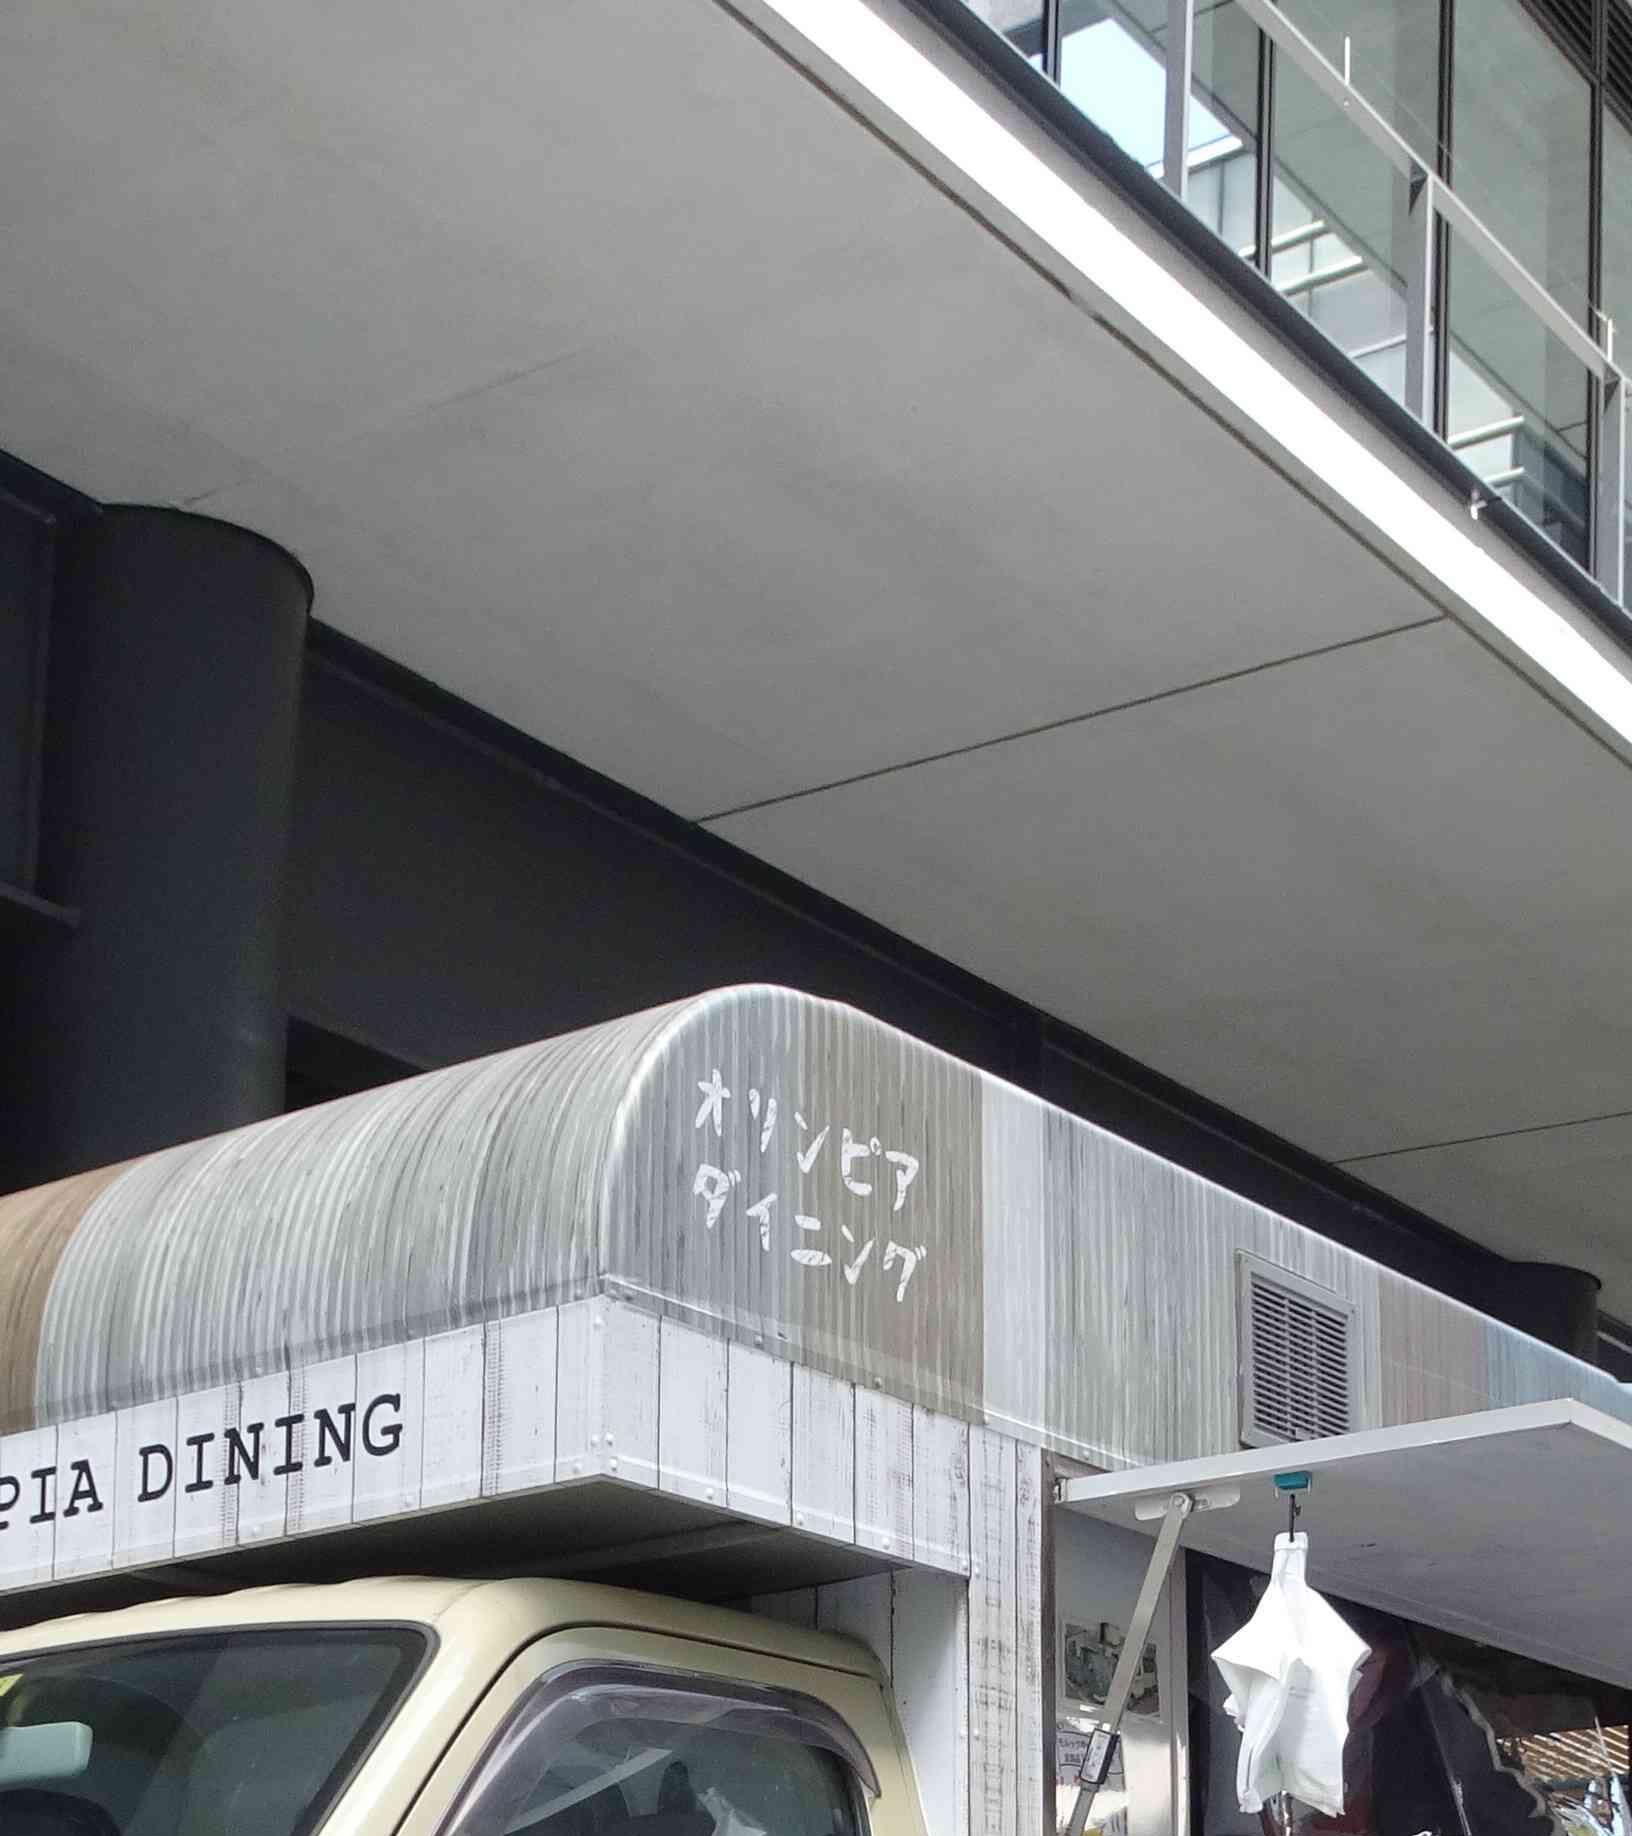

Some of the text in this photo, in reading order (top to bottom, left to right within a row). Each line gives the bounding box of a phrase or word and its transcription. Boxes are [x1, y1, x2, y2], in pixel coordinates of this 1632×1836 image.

[695, 1068, 919, 1212] オリンピア
[693, 1163, 927, 1303] ダイニング
[136, 1393, 404, 1503] DINING
